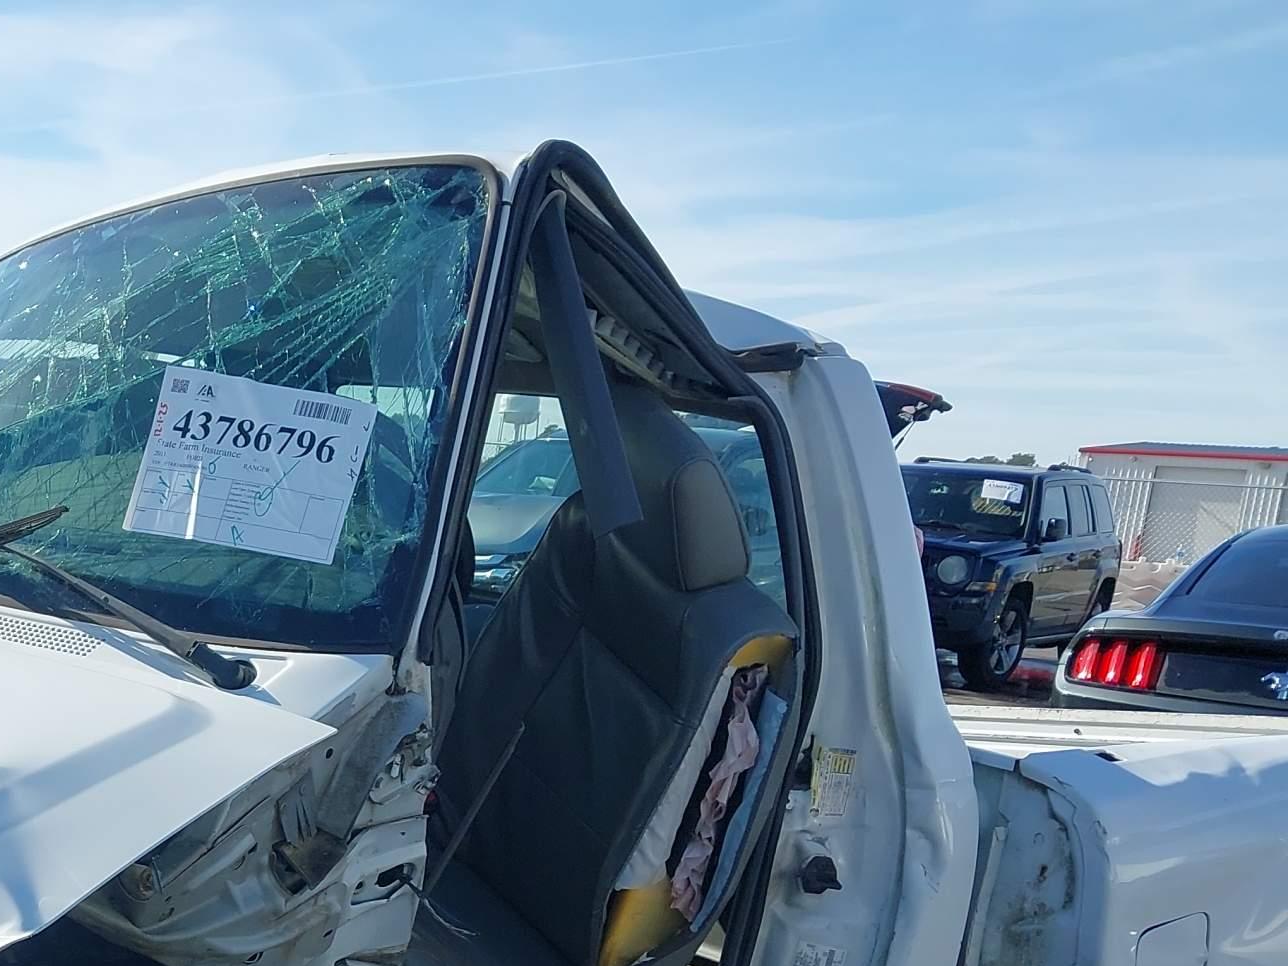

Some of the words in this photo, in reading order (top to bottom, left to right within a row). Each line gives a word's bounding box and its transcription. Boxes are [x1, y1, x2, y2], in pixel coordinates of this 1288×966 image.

[172, 409, 342, 464] 43786796
[178, 441, 199, 452] Farm
[201, 443, 242, 459] Insurance
[243, 463, 270, 473] RANGER
